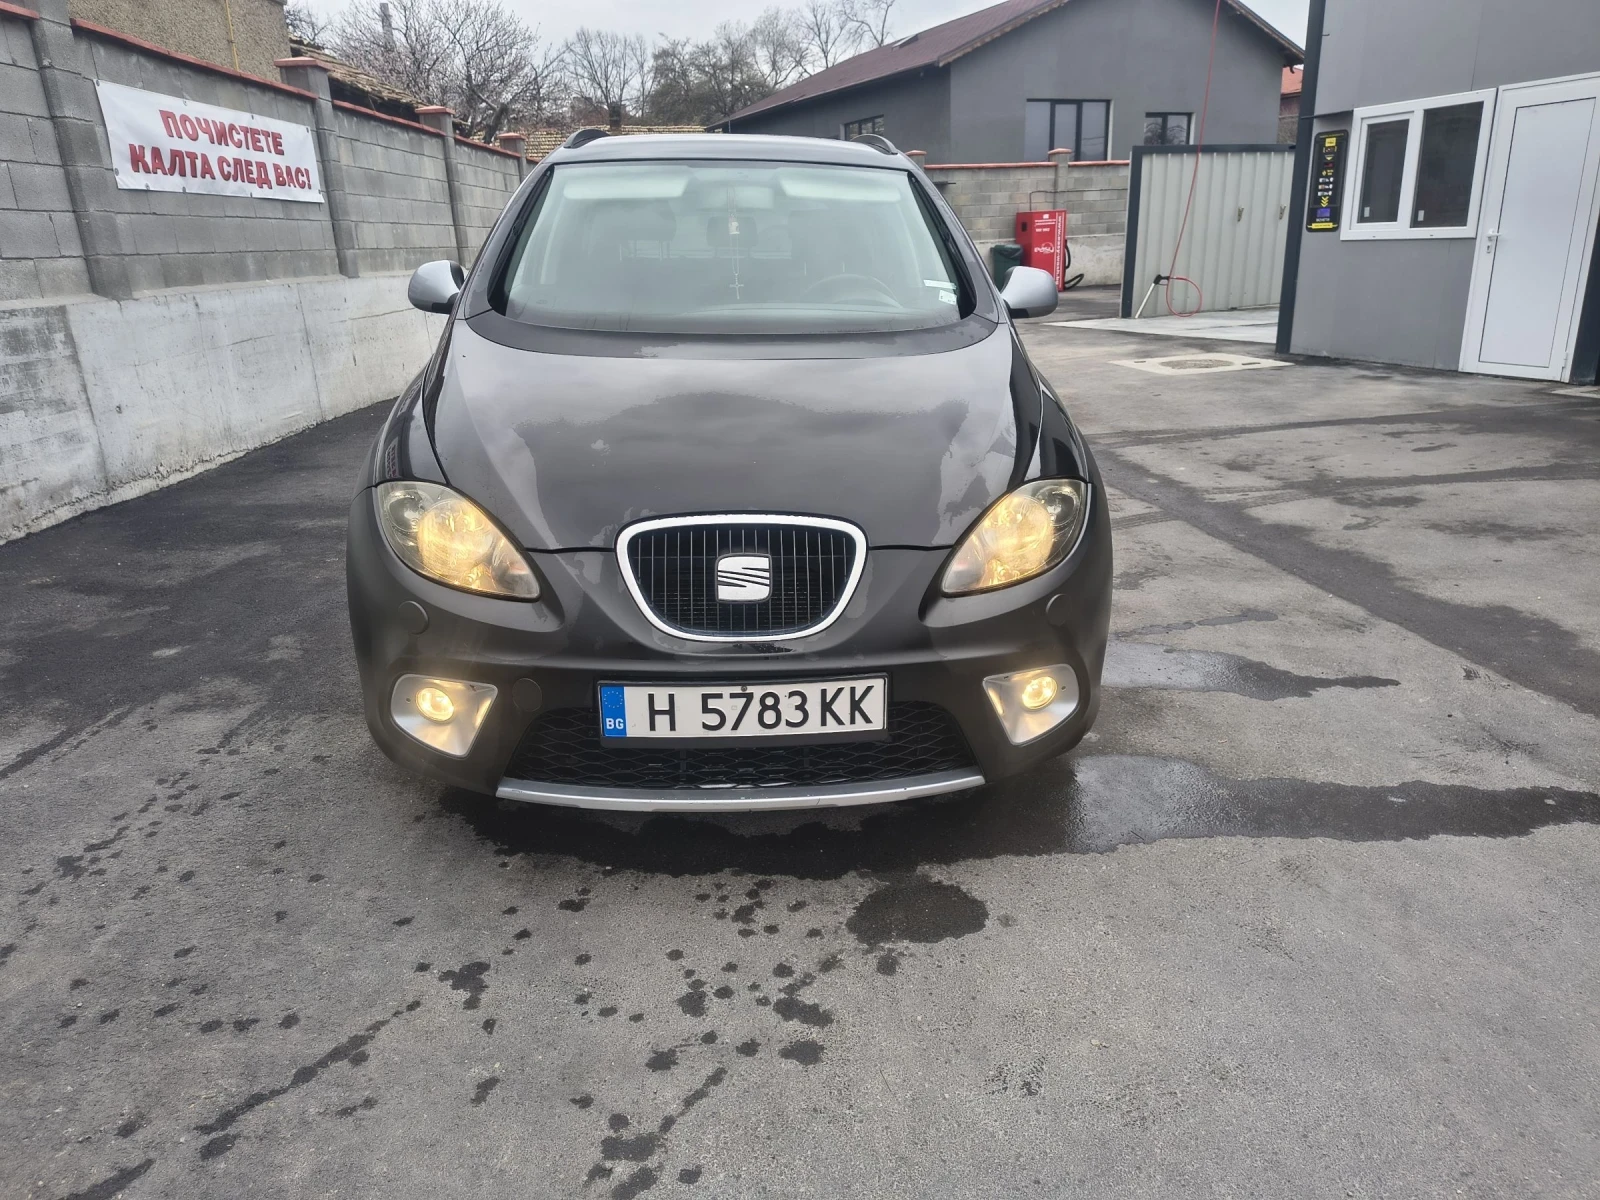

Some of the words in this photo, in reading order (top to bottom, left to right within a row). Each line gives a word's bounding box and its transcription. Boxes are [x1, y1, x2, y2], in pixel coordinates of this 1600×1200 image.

[159, 109, 285, 156] ПОЧИСТЕТЕ
[129, 143, 216, 180] КАЛТА
[217, 155, 273, 190] СЛЕД
[272, 163, 312, 190] ВАС!
[606, 717, 624, 730] BG
[647, 692, 677, 732] H
[701, 691, 809, 731] 5783
